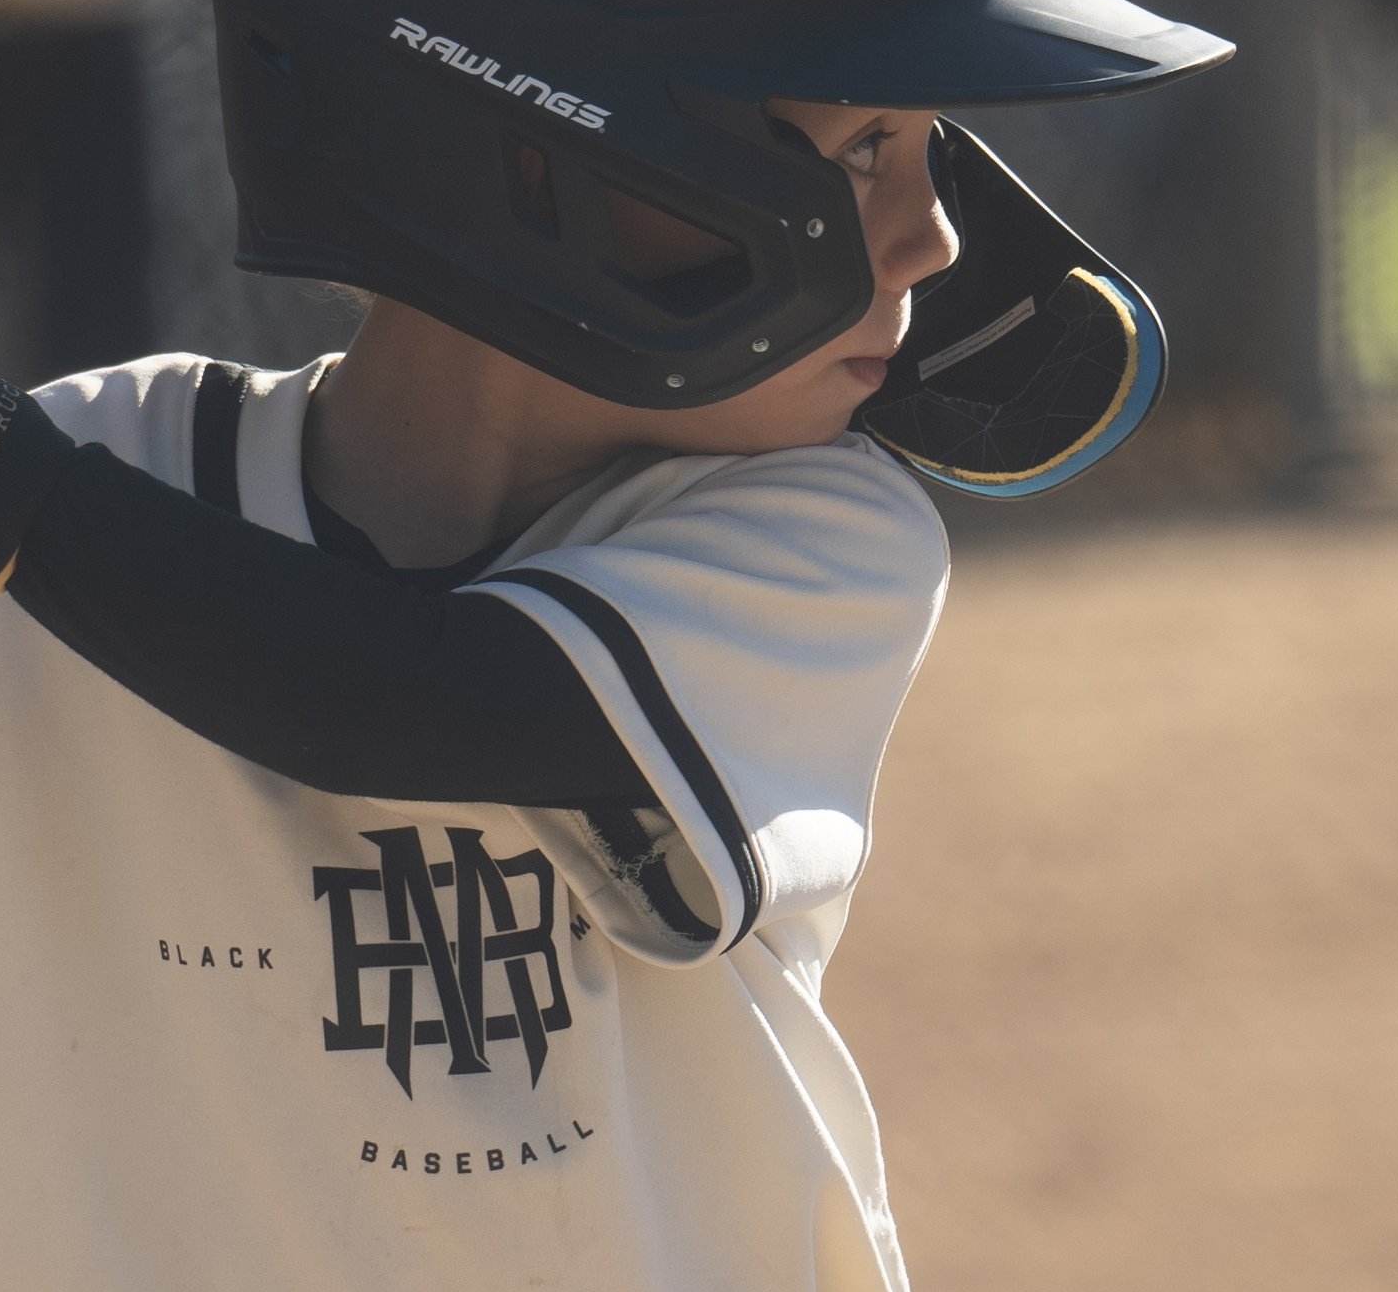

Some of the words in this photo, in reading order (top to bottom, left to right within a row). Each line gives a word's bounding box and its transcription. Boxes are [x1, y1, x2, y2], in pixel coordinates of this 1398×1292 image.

[390, 17, 612, 133] RAWLINGS
[158, 939, 274, 970] BLACK
[360, 1120, 594, 1175] BASEBALL
